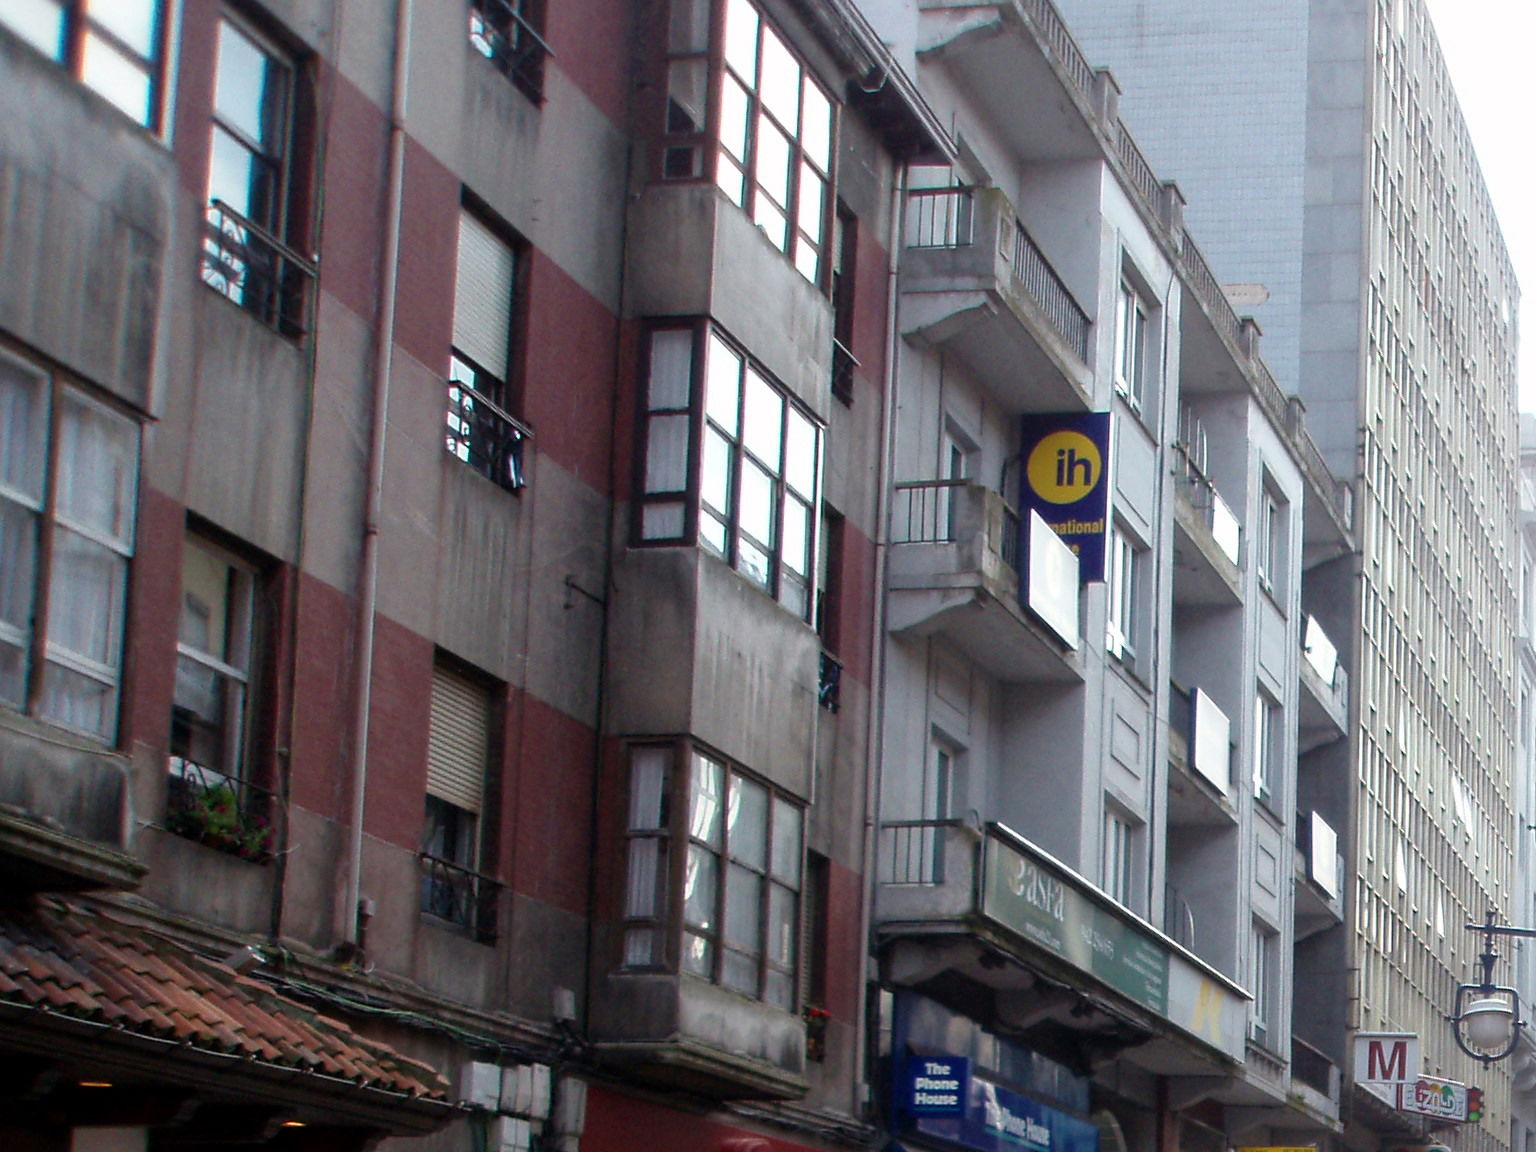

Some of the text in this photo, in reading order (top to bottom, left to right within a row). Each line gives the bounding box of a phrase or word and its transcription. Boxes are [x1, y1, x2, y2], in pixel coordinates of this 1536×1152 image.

[1056, 449, 1091, 487] ih
[924, 1062, 952, 1075] The
[1367, 1040, 1408, 1081] M
[914, 1077, 959, 1091] Phone
[914, 1092, 958, 1106] House
[1002, 1105, 1026, 1138] Phone
[1026, 1116, 1050, 1147] House
